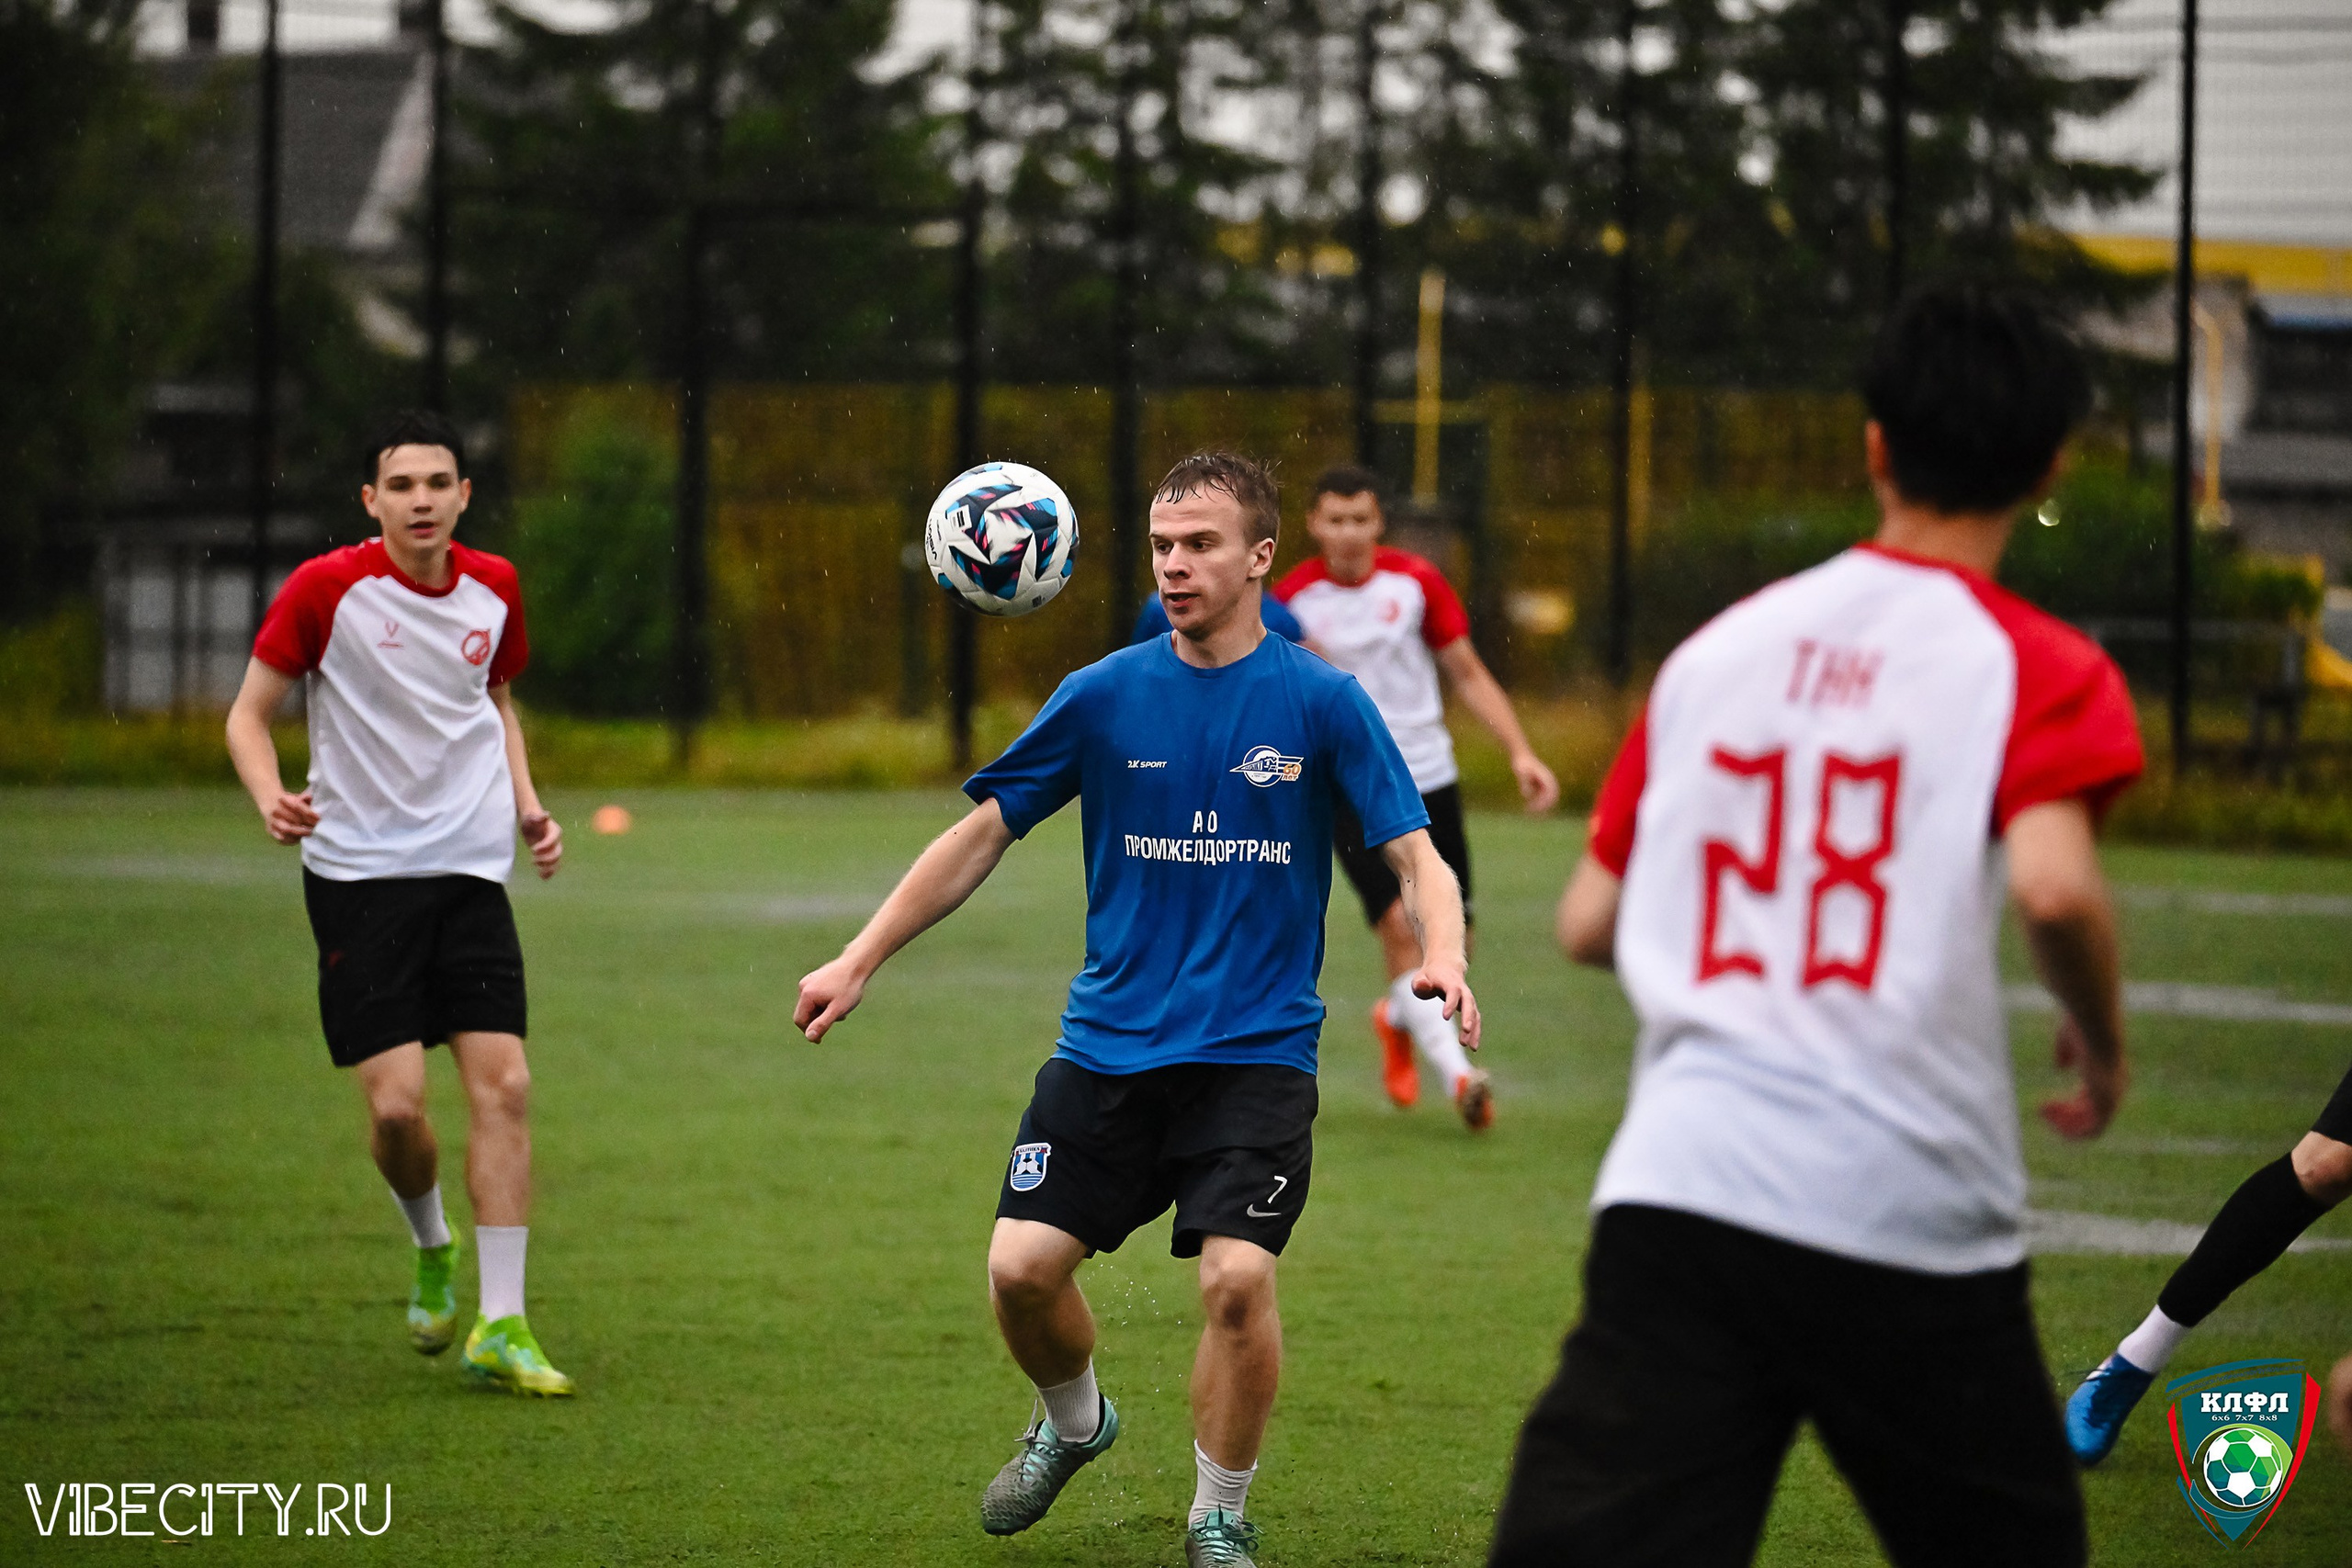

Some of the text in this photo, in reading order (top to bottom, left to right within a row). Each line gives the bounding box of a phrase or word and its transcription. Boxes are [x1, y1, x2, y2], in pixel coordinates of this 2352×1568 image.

[1139, 761, 1168, 769] SPORT
[1283, 763, 1300, 775] 60
[1125, 834, 1292, 866] ПРОМЖЕЛДОРТРАНС
[1697, 745, 1900, 991] 28
[1267, 1176, 1287, 1204] 7
